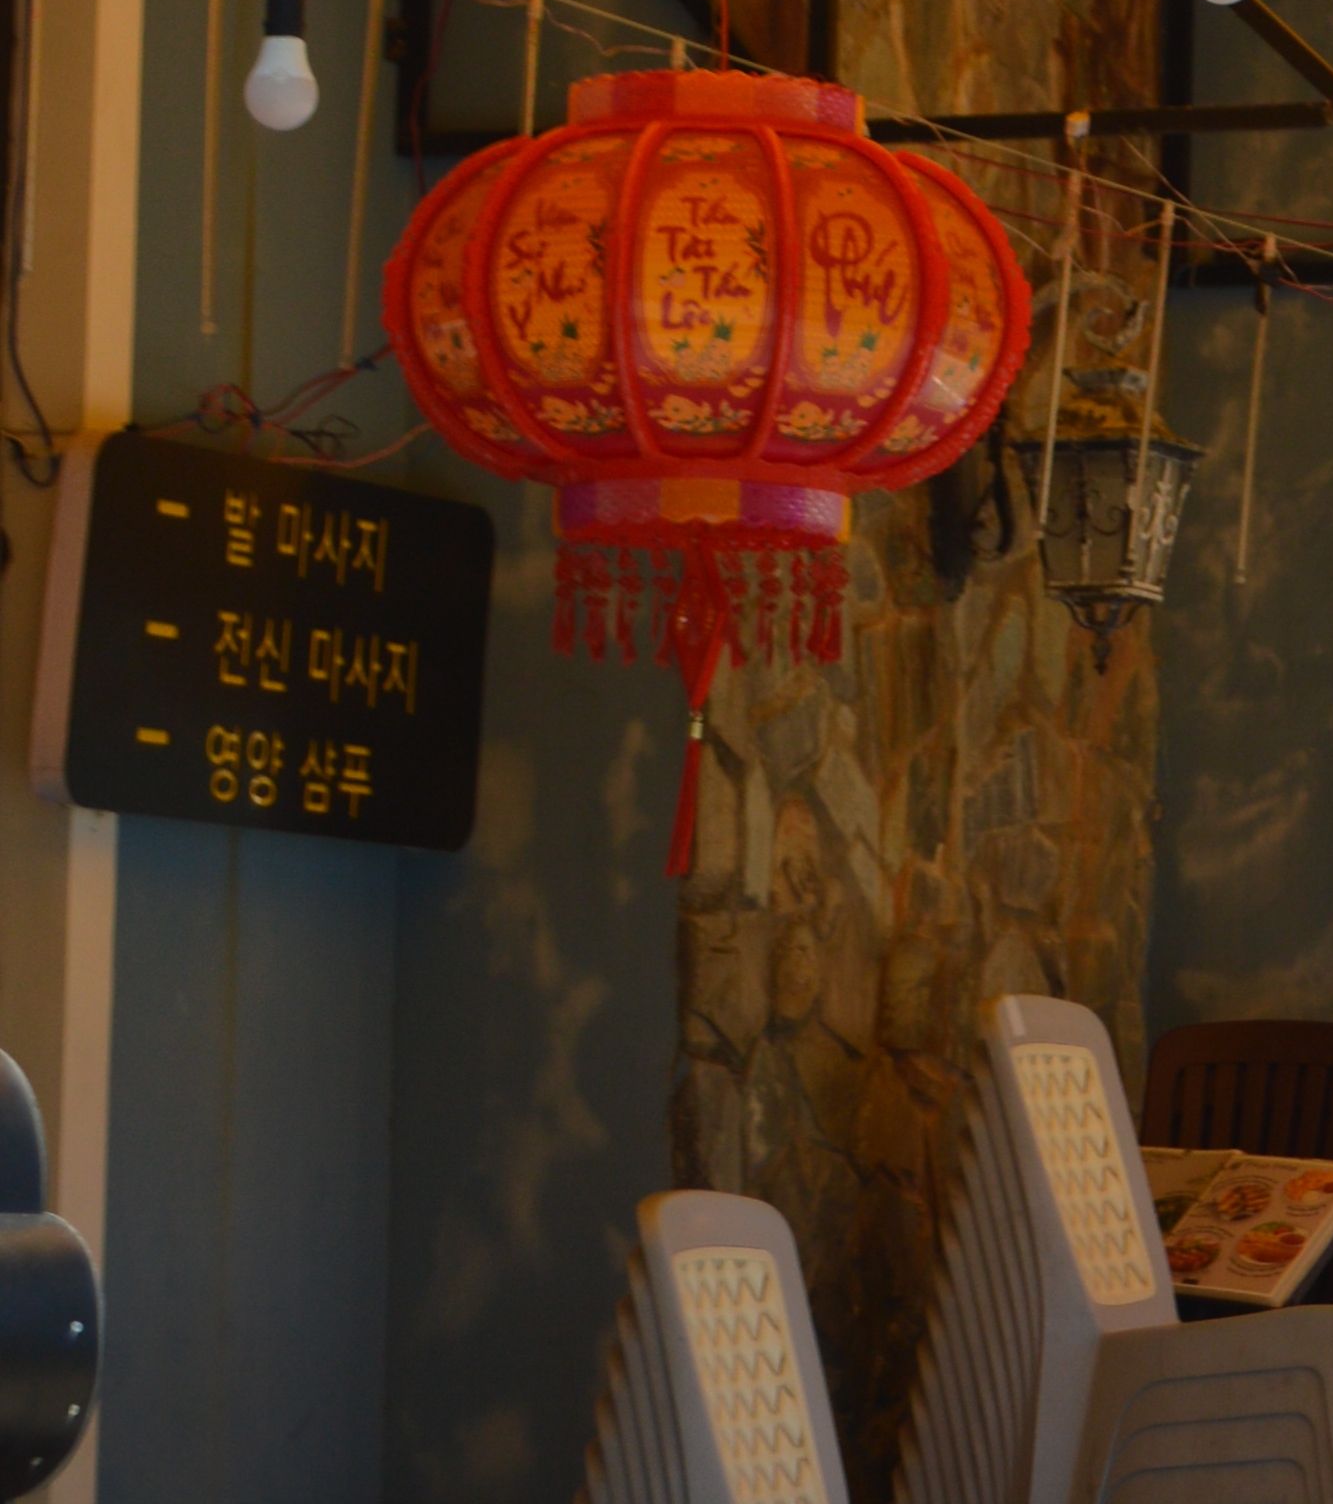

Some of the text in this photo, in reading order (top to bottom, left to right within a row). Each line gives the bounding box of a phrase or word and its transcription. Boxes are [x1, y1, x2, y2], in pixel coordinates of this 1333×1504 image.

[223, 489, 390, 594] 발 마사지
[214, 608, 418, 715] 전신 마사지
[204, 723, 374, 820] 영양 샴푸
